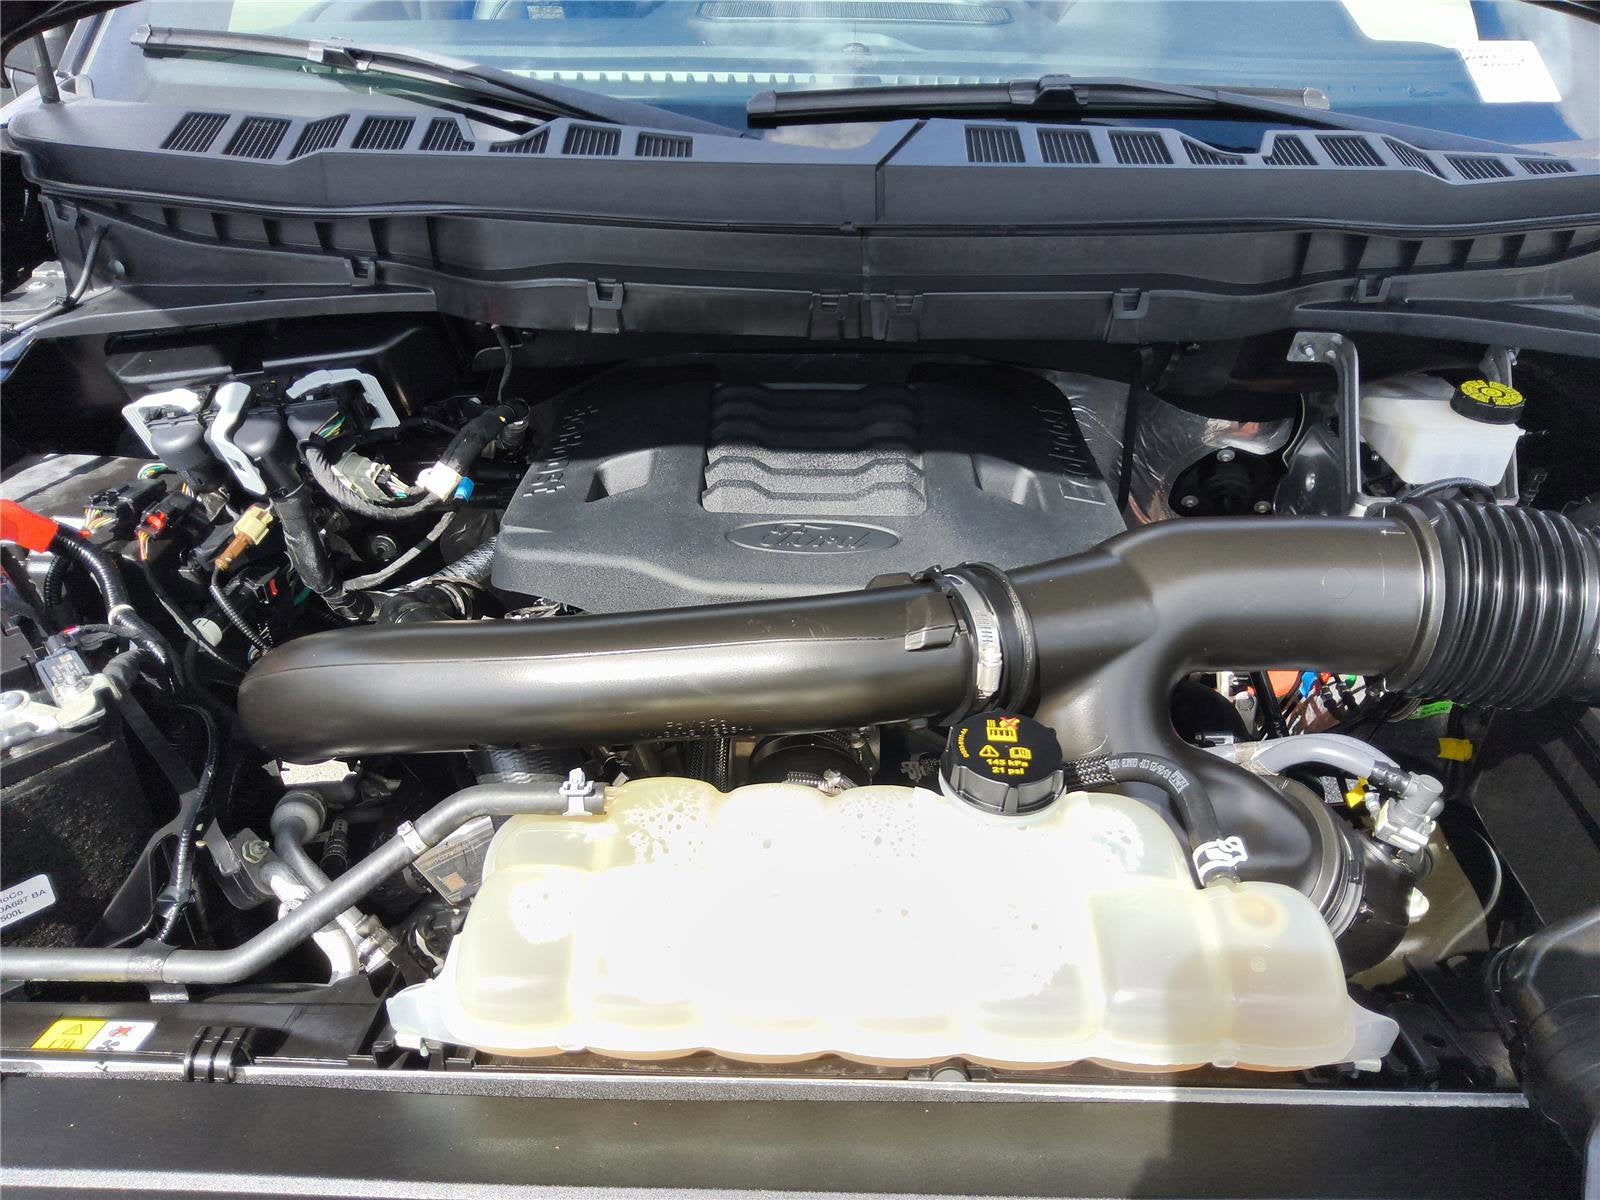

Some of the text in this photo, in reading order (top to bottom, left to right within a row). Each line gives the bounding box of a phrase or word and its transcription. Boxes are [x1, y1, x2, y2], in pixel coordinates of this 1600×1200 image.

[760, 523, 872, 550] Ford
[1007, 759, 1029, 768] kPa
[31, 889, 46, 899] BA
